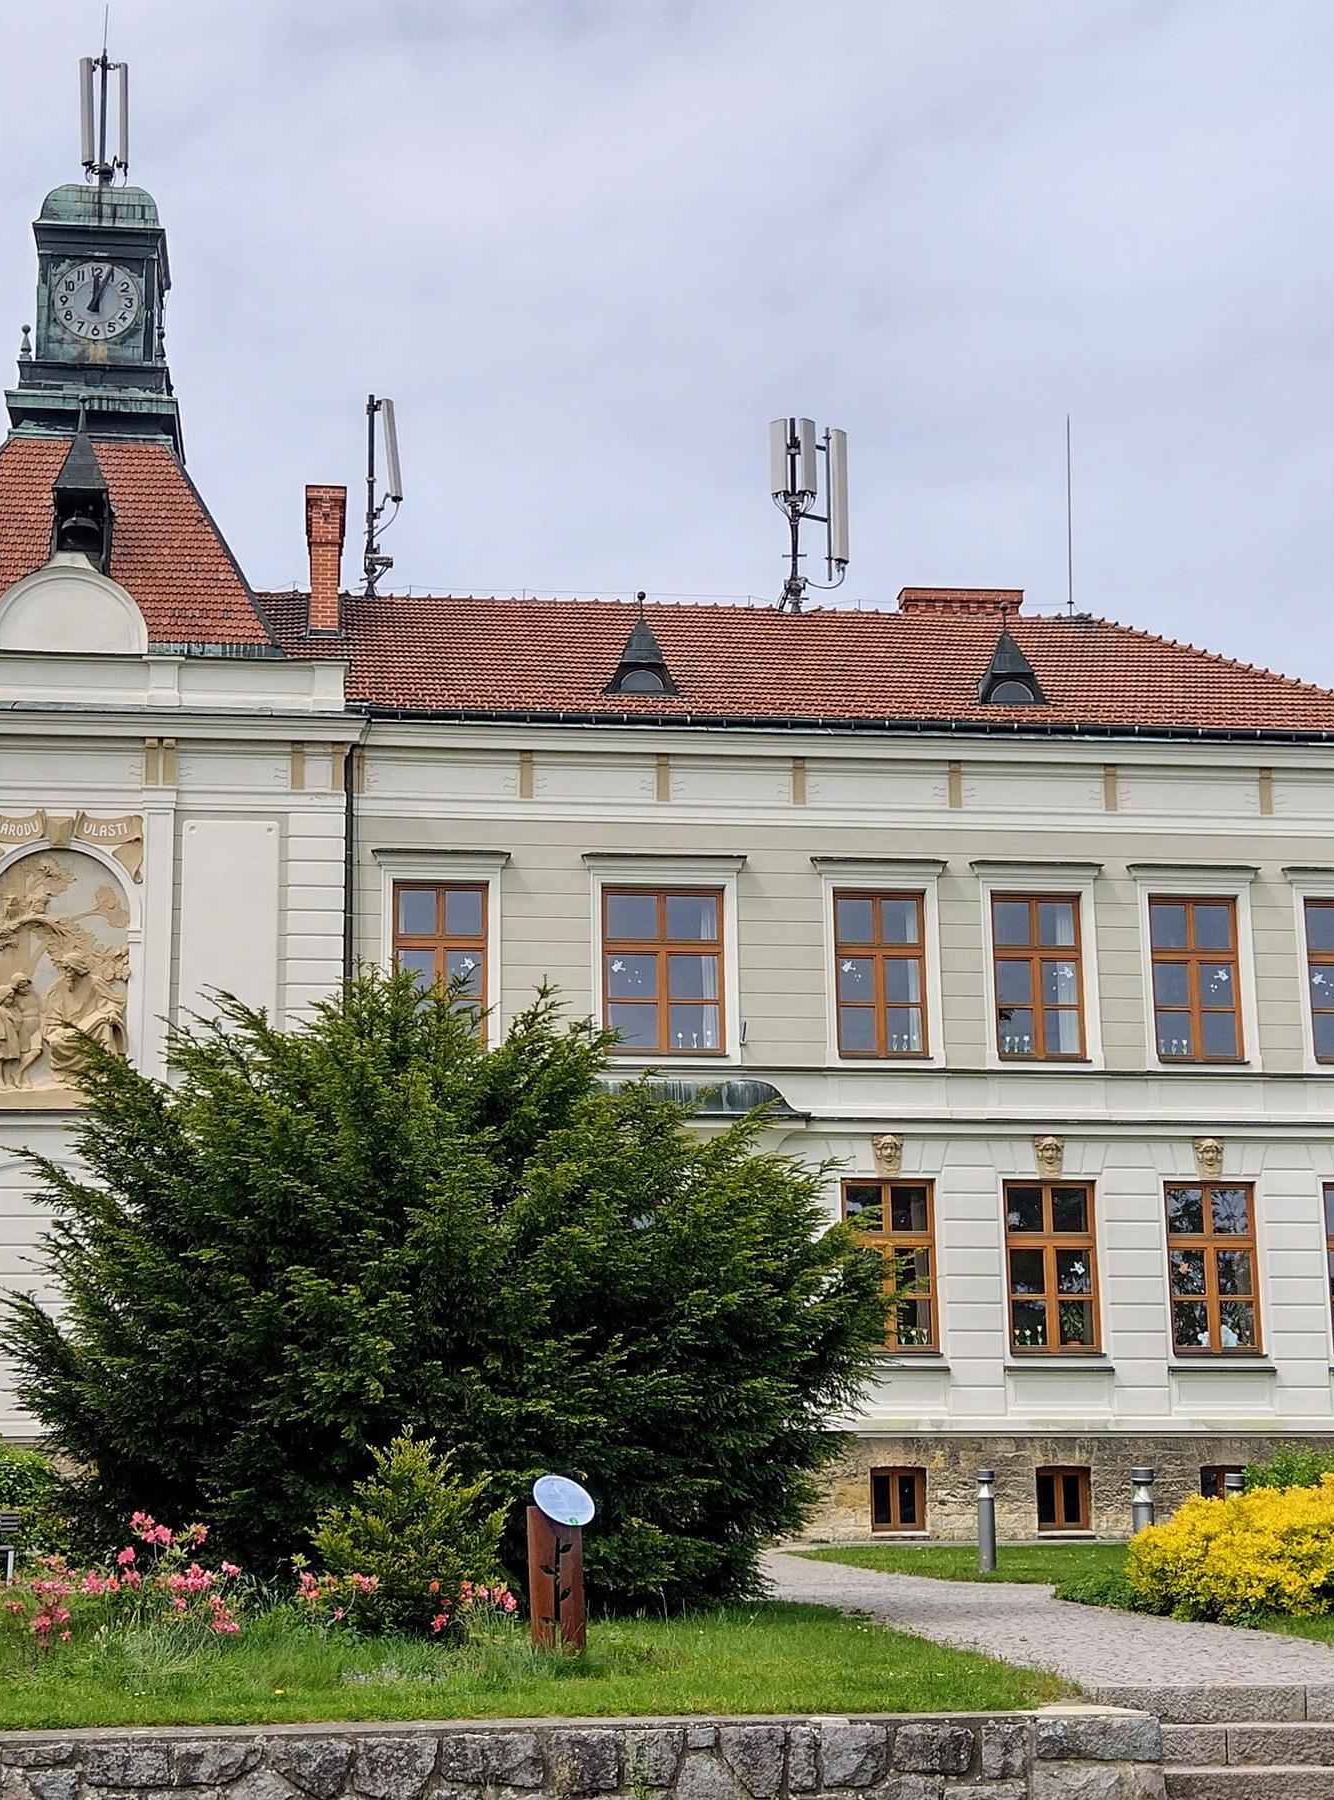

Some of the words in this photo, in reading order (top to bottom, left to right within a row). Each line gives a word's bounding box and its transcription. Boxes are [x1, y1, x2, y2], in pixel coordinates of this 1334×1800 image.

[77, 270, 85, 281] 11
[91, 266, 103, 279] 12
[64, 280, 75, 292] 10
[120, 281, 130, 293] 2
[59, 295, 69, 306] 9
[124, 297, 134, 309] 3
[64, 309, 73, 321] 8
[118, 311, 128, 323] 4
[77, 321, 85, 332] 7
[91, 325, 100, 336] 6
[107, 322, 117, 333] 5
